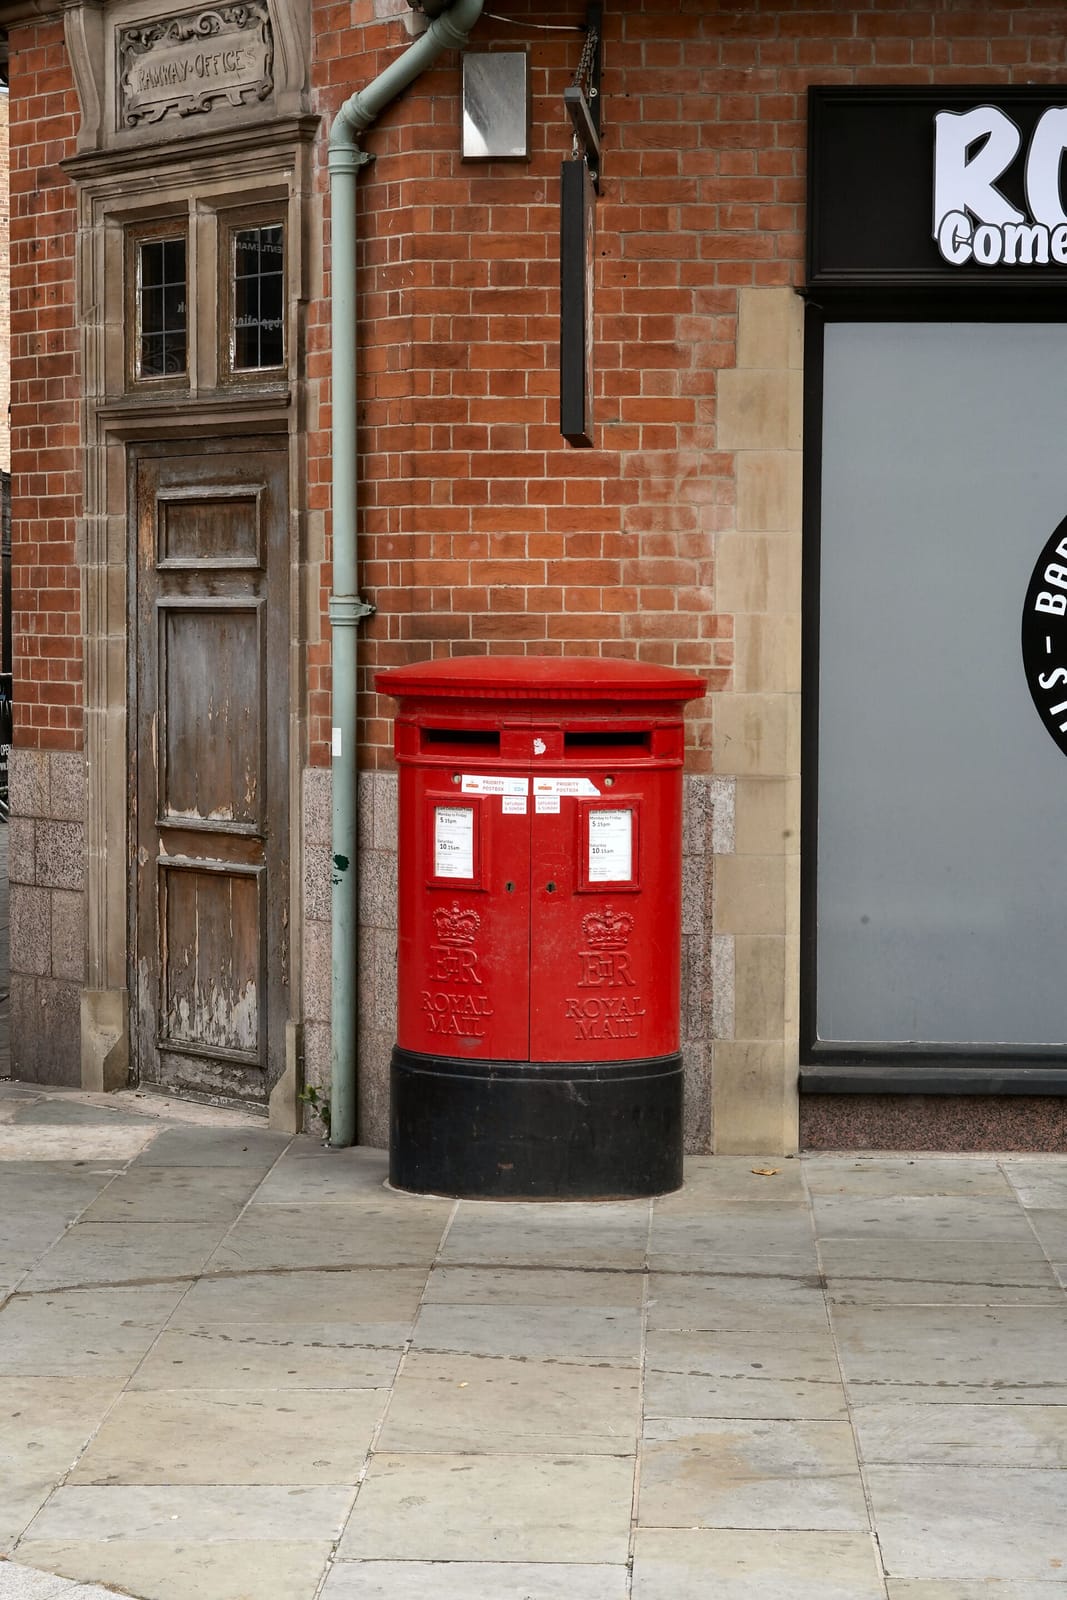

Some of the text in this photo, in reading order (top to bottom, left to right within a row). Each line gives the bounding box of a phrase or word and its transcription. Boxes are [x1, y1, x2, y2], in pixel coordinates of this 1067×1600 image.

[194, 48, 257, 78] OFFICES
[421, 991, 494, 1016] ROYAL
[565, 996, 646, 1019] ROYAL
[427, 1013, 486, 1037] MAIL
[575, 1018, 638, 1041] MAIL
